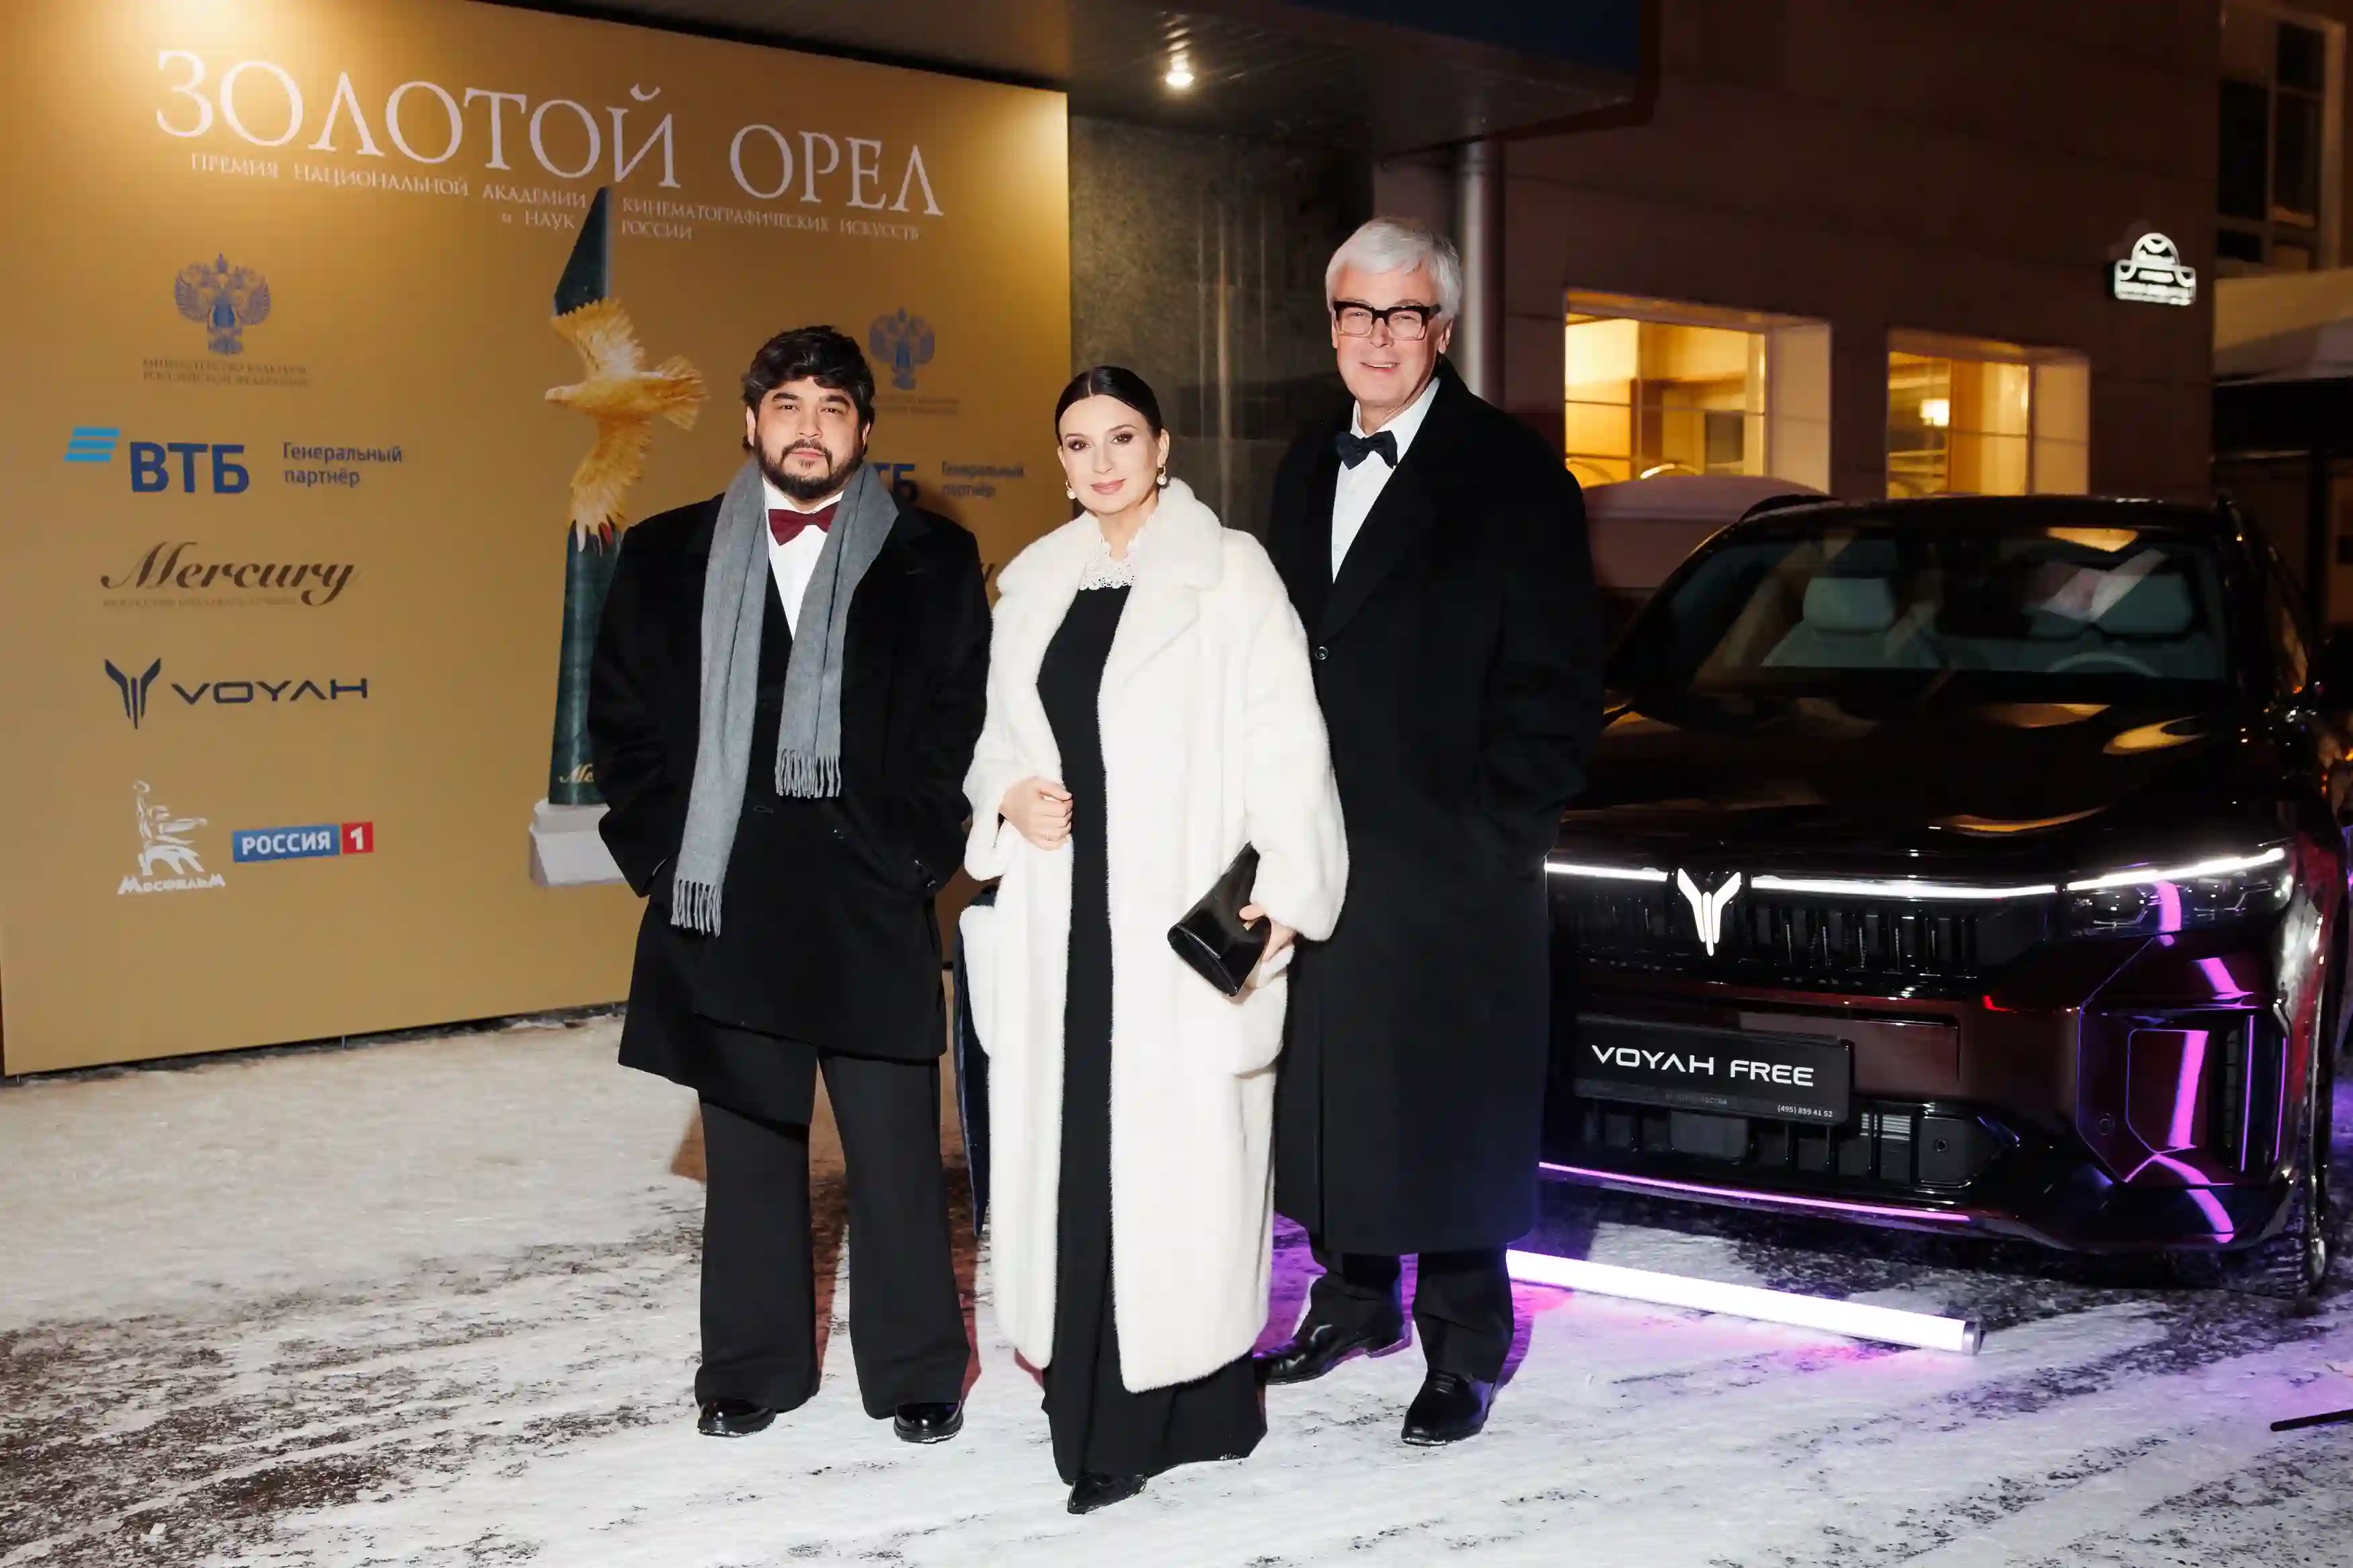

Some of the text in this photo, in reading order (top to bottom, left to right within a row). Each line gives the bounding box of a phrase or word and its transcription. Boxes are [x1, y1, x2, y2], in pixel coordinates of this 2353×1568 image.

[157, 50, 944, 216] ЗОЛОТОЙ ОРЕЛ
[191, 152, 279, 179] ПРЕМИЯ
[294, 163, 469, 197] НАЦИОНАЛЬНОЙ
[482, 183, 587, 208] АКАДЕМИИ
[622, 197, 830, 233] КИНЕМАТОГРАФИЧЕСКИХ
[524, 209, 575, 231] НАУК
[621, 220, 692, 241] РОССИИ
[130, 441, 249, 494] ВТБ
[282, 442, 403, 464] Генеральный
[284, 466, 361, 488] партнёр
[100, 541, 362, 607] Mercury
[171, 677, 368, 705] VOYAH
[241, 826, 364, 856] РОССИЯ 1
[1591, 1044, 1814, 1087] VOYAH FREE
